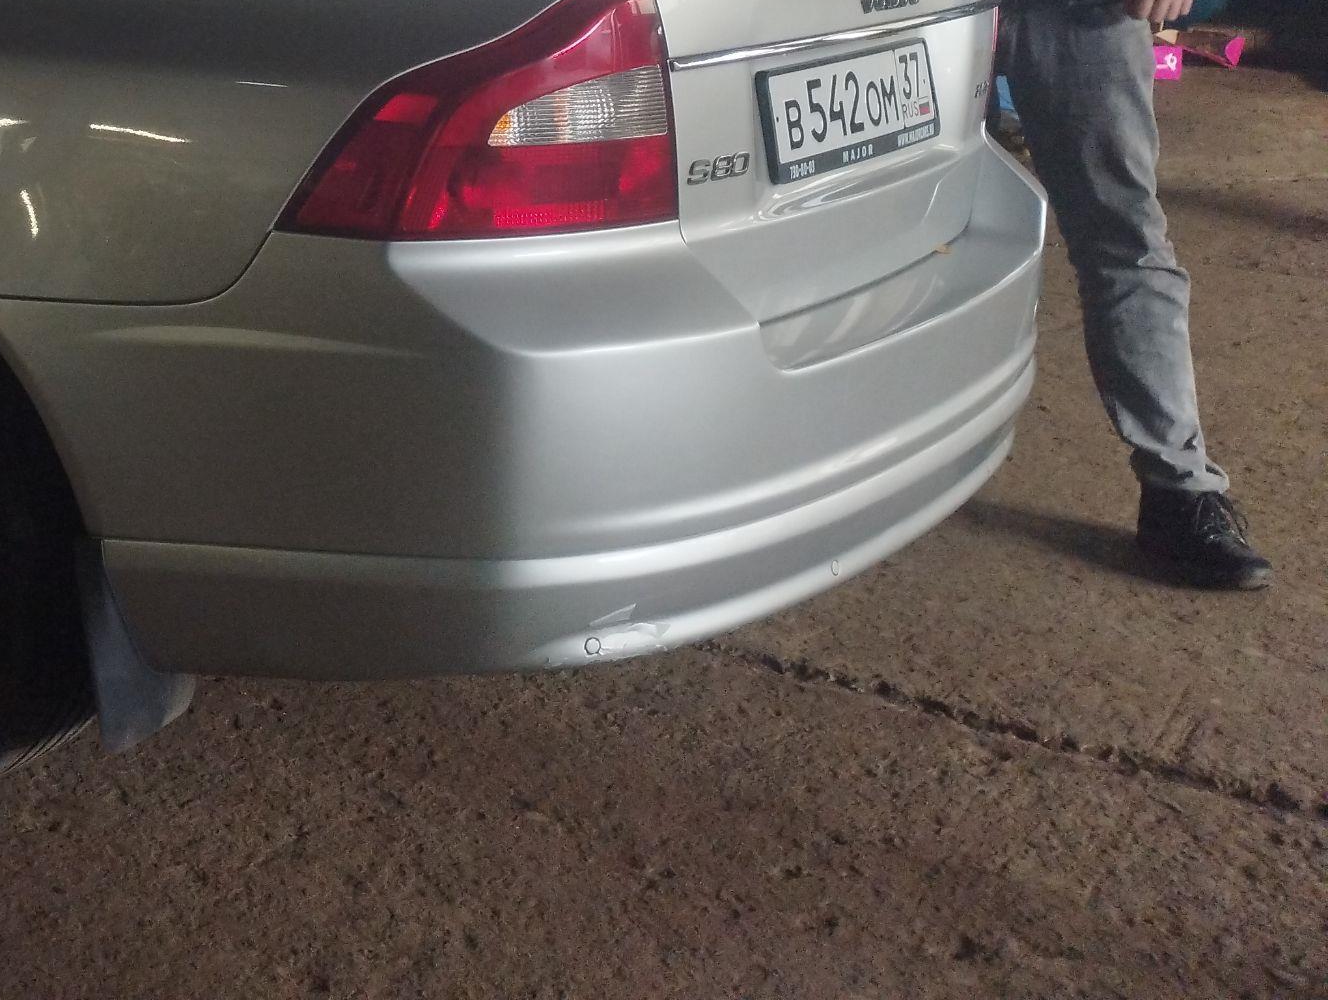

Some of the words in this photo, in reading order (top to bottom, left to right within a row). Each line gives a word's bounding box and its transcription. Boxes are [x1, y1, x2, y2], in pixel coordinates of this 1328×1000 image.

[784, 71, 900, 151] В542ОМ
[898, 52, 920, 100] 37
[902, 101, 919, 118] RUS
[842, 144, 873, 163] MAJOR
[687, 151, 750, 185] S80
